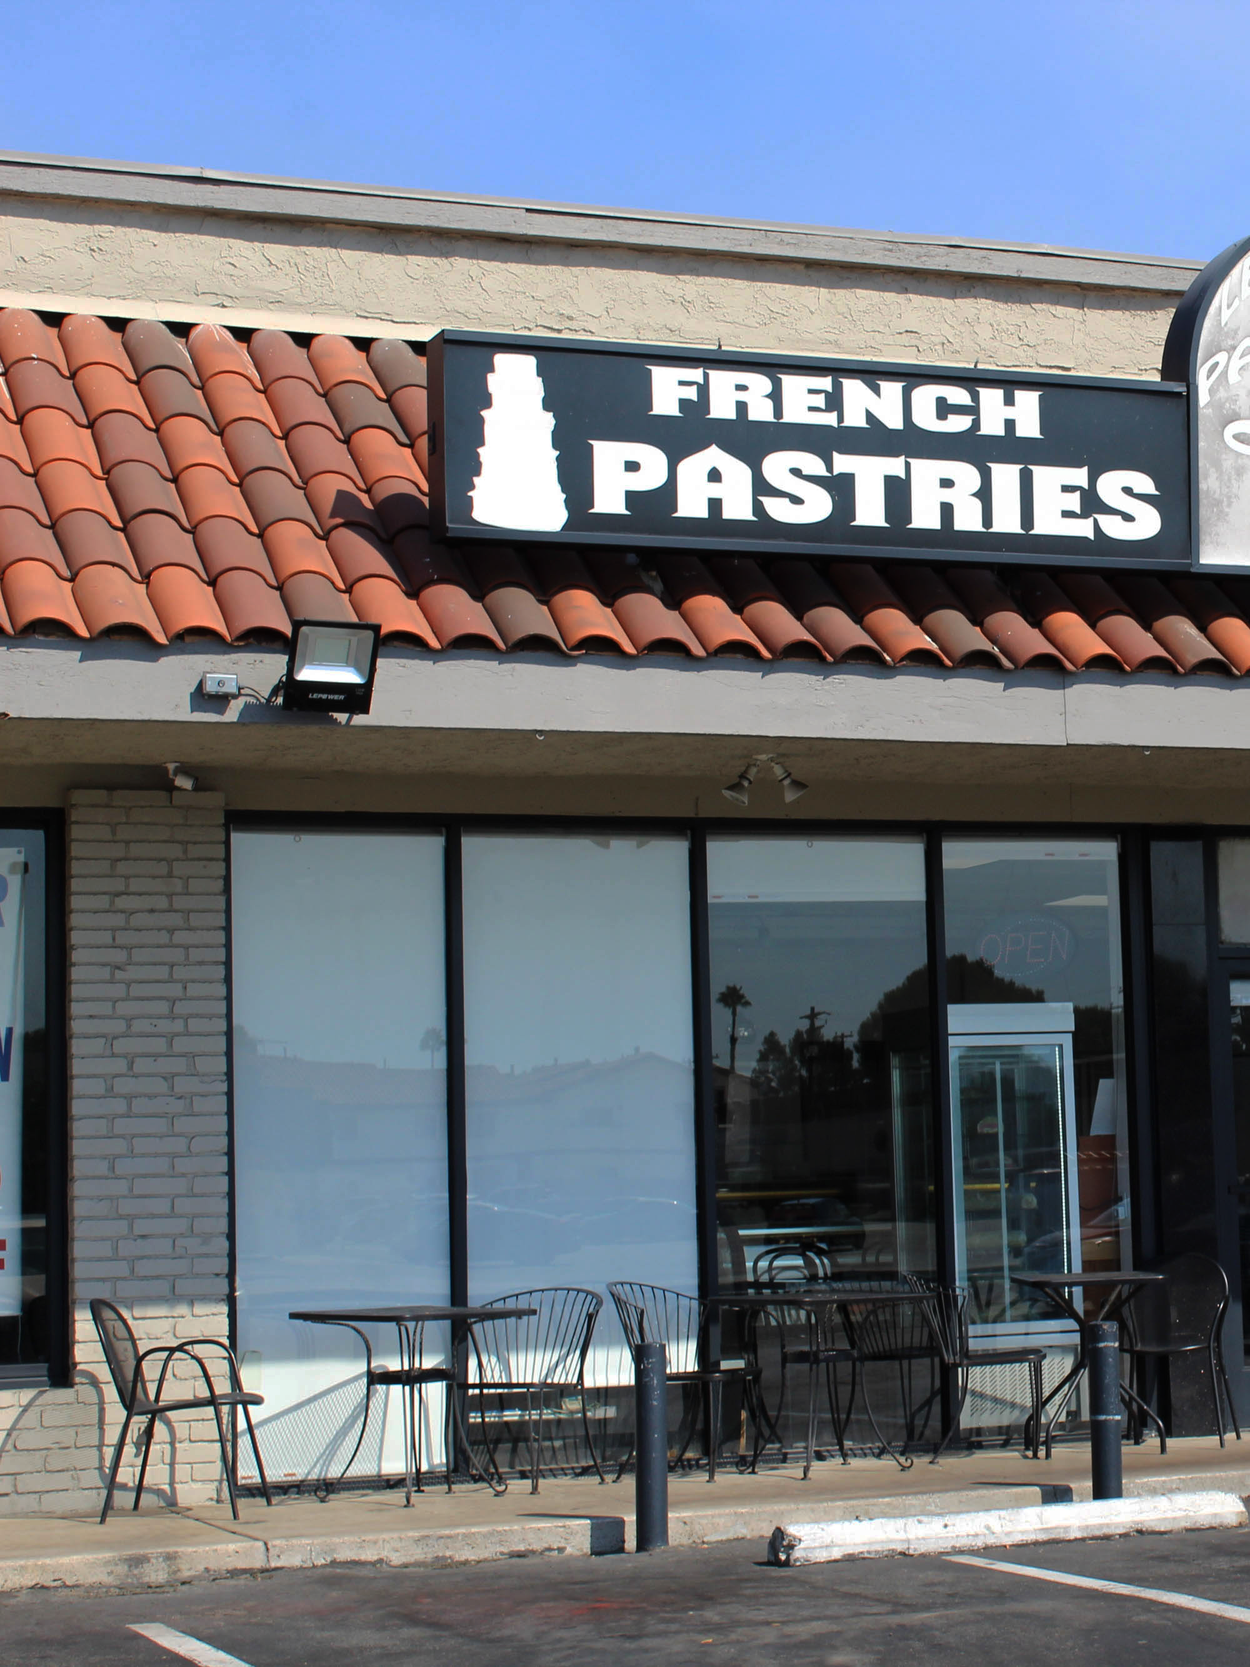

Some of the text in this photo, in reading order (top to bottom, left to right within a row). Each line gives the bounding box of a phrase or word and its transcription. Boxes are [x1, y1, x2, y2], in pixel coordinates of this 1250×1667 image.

[645, 366, 1044, 439] FRENCH
[588, 440, 1162, 541] PASTRIES
[979, 929, 1070, 966] OPEN
